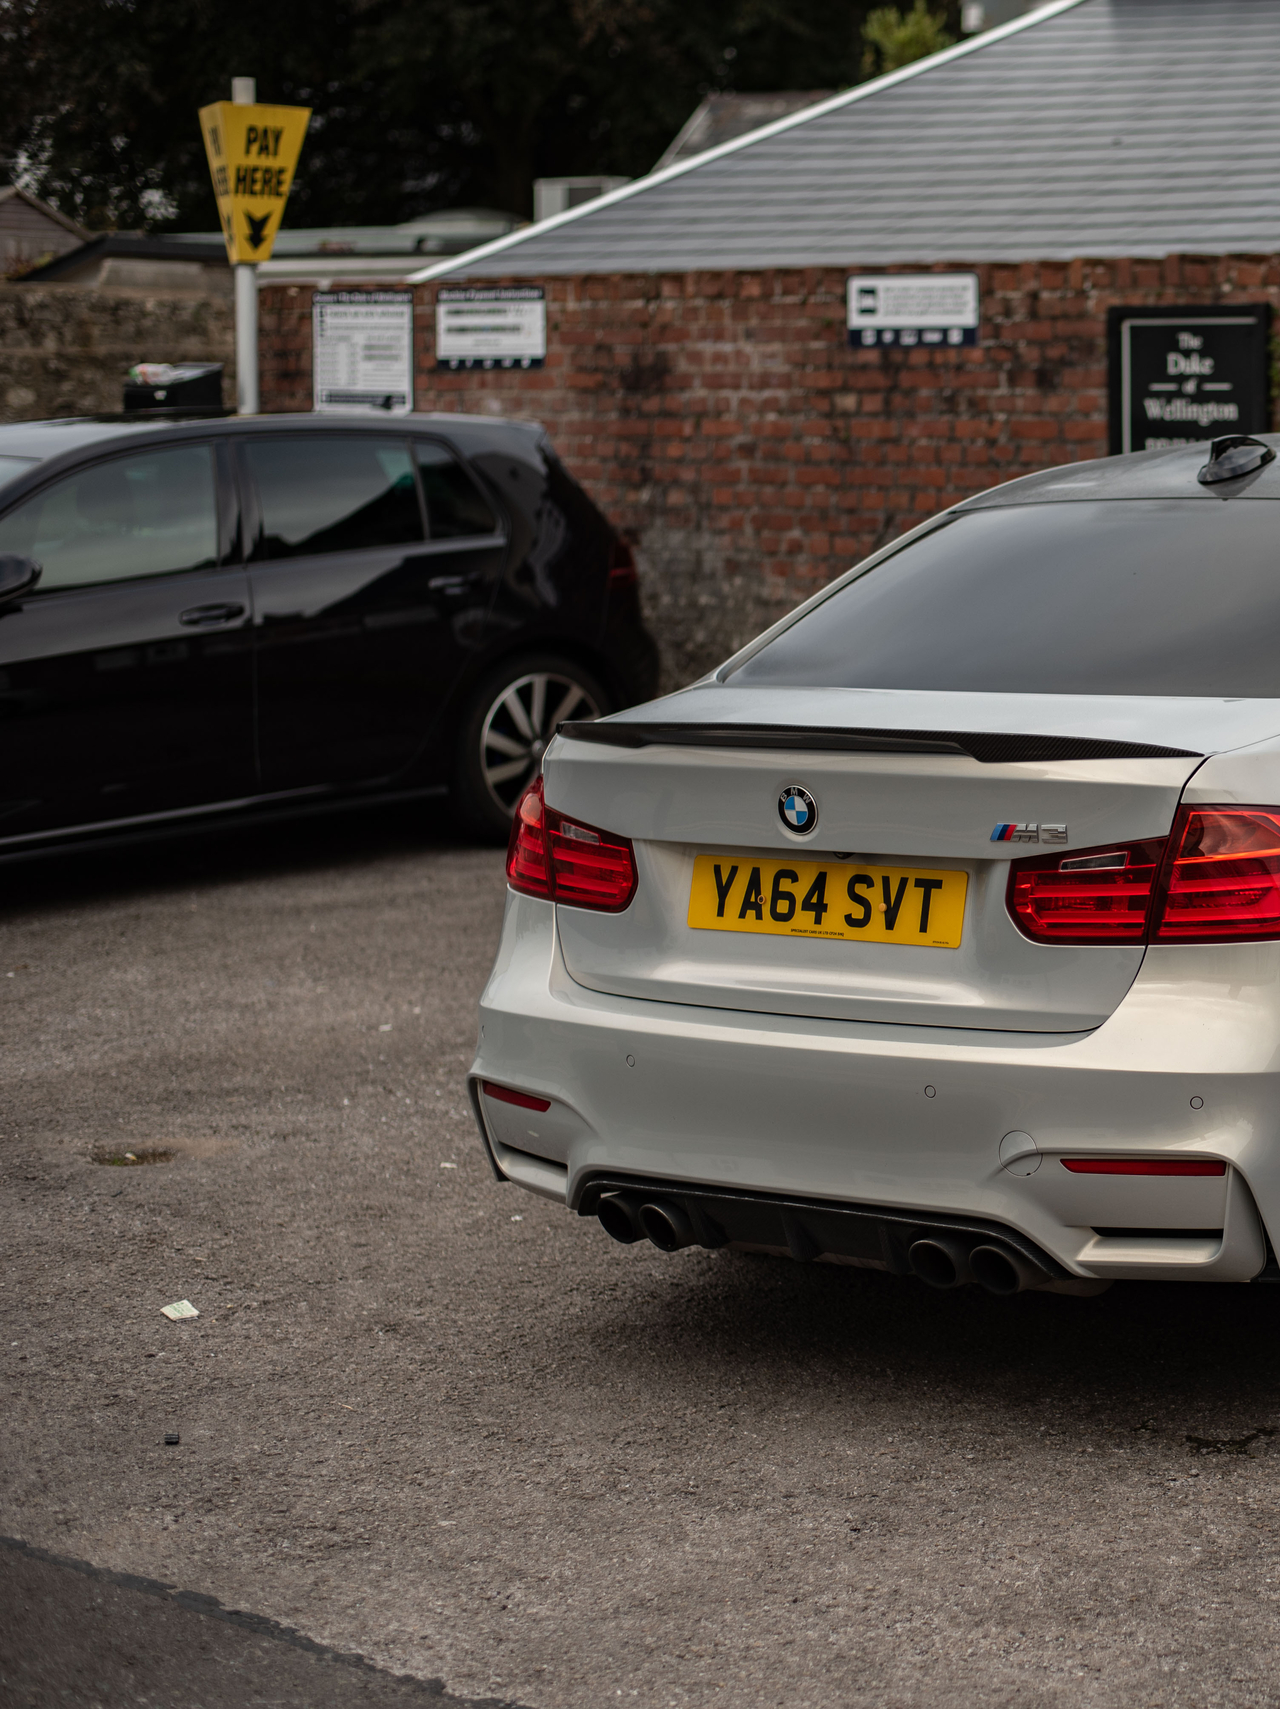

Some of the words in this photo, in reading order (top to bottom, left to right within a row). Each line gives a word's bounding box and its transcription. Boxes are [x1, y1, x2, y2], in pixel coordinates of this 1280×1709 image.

[245, 126, 285, 158] PAY
[234, 166, 287, 197] HERE
[1176, 331, 1204, 350] The
[1167, 351, 1214, 375] Duke
[1181, 377, 1198, 395] of
[1143, 397, 1239, 427] Wellington
[780, 787, 811, 803] BMW
[1003, 822, 1068, 844] M3
[713, 864, 828, 925] YA64
[843, 873, 943, 933] SVT
